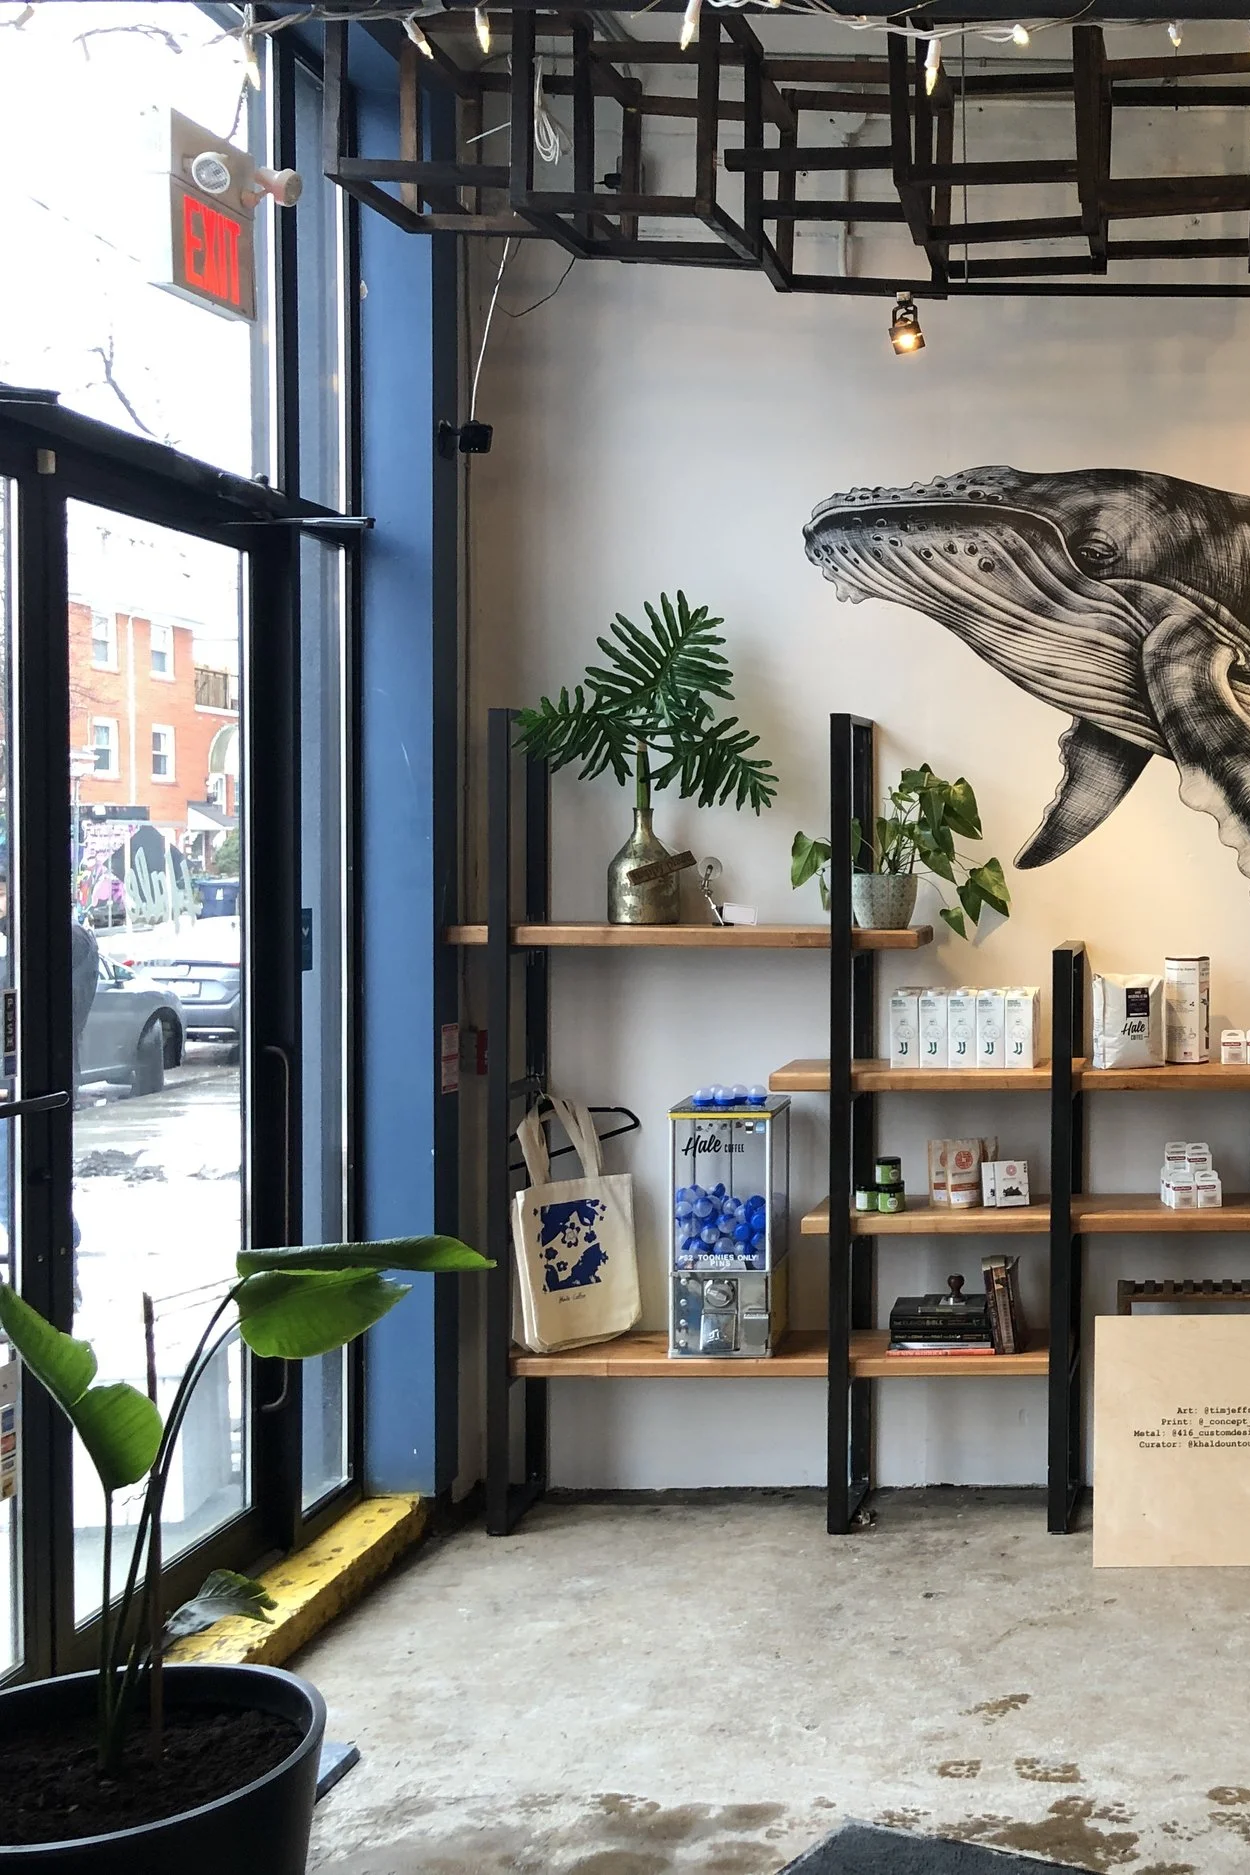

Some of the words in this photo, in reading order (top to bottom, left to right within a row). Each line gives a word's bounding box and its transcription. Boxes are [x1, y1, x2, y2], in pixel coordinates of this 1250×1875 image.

[184, 194, 241, 305] EXIT
[6, 998, 14, 1048] PUSH
[1121, 1020, 1146, 1036] Hale
[682, 1134, 722, 1157] Hale
[725, 1144, 744, 1152] COFFEE
[1177, 1407, 1197, 1416] Art:
[1161, 1418, 1192, 1428] Print:
[1134, 1429, 1165, 1438] Metal:
